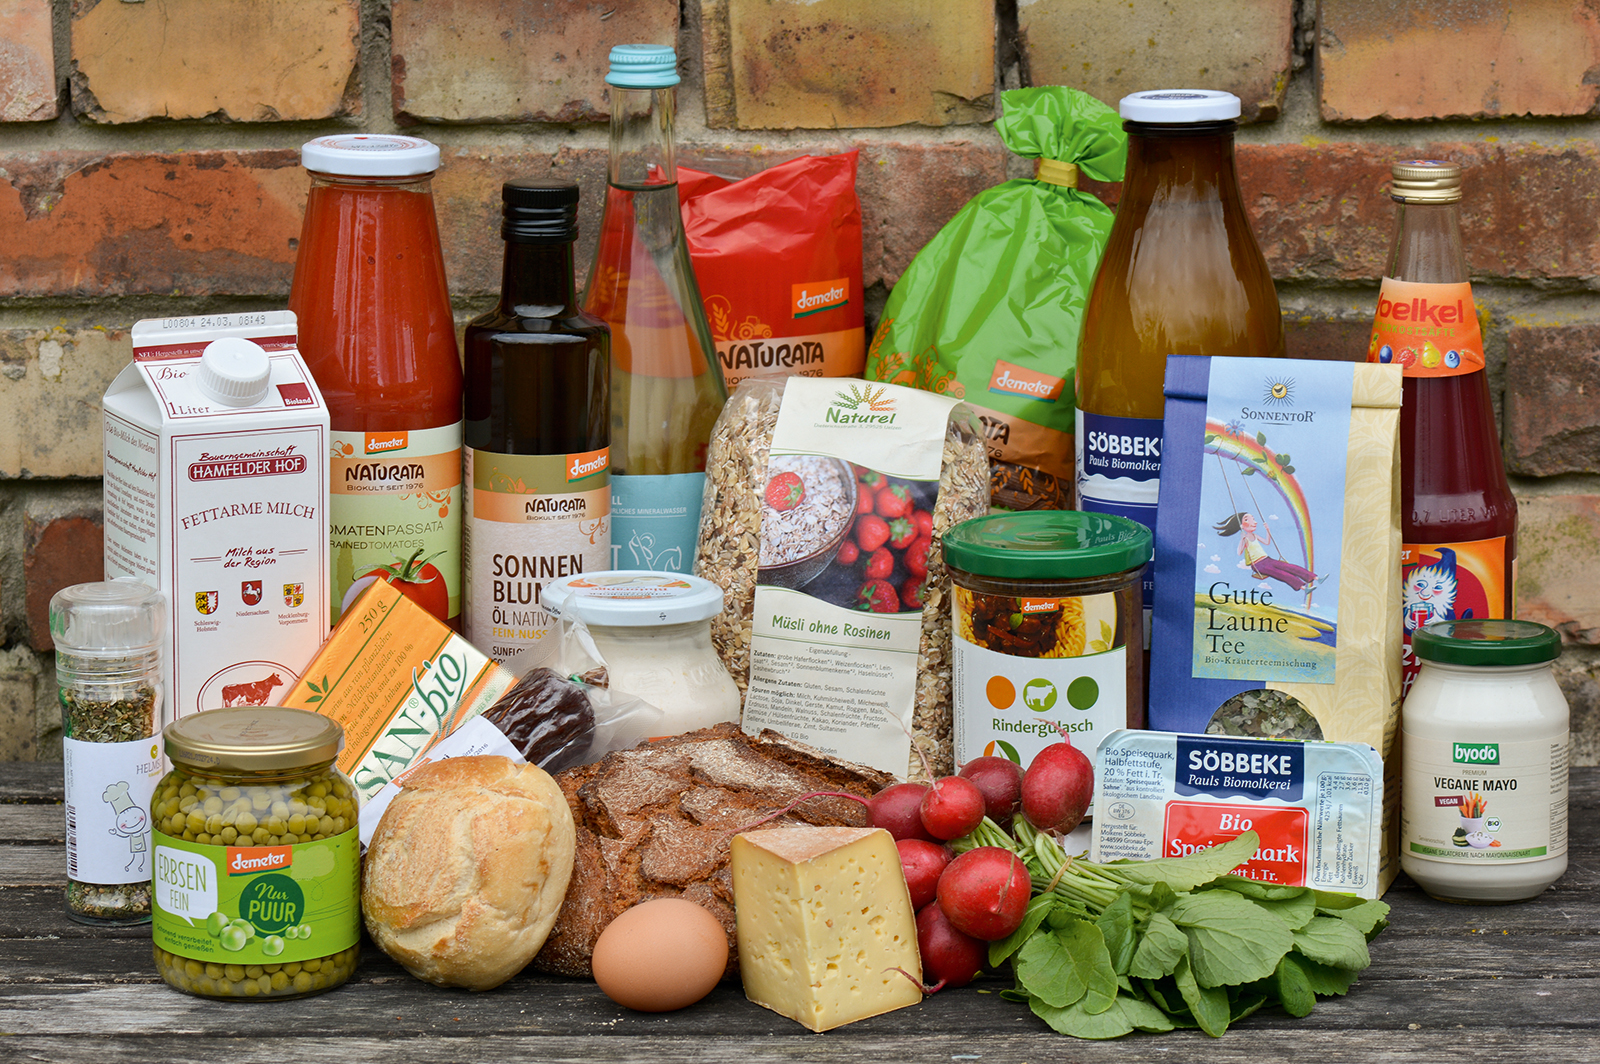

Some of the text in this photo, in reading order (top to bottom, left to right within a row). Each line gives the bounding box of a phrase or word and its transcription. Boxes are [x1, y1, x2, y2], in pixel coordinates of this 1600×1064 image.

[797, 287, 844, 309] demeter
[163, 318, 195, 329] L00804
[239, 315, 265, 324] 08:49
[1374, 321, 1455, 336] ATURKOSTSÄFTE
[718, 342, 824, 369] NATURATA
[156, 367, 189, 380] Bio
[996, 370, 1054, 394] demeter
[179, 405, 209, 414] Liter
[285, 397, 311, 405] Bioland
[826, 407, 896, 424] Naturel
[368, 438, 403, 450] demeter
[988, 446, 1002, 458] 76
[1089, 431, 1162, 457] SÖBBEK
[199, 445, 297, 462] Bauerngemeinschaft
[193, 459, 301, 479] HAMFELDER HOF
[570, 455, 607, 477] demeter
[1089, 455, 1161, 471] Pauls Biomolker
[346, 464, 424, 481] NATURATA
[525, 498, 586, 514] NATURATA
[612, 496, 622, 505] LL
[181, 502, 315, 530] FETTARME MILCH
[225, 547, 252, 557] Milch
[330, 541, 368, 549] RAINED
[224, 557, 276, 568] der Region
[493, 554, 583, 578] SONNEN
[494, 580, 541, 604] BLU
[1209, 582, 1273, 606] Gute
[1024, 601, 1055, 612] demeter
[358, 600, 388, 632] 250 g
[492, 606, 549, 626] ÖL NATIV
[1207, 608, 1288, 633] Laune
[493, 627, 548, 639] FEIN-NUSS
[772, 615, 891, 640] Müsli ohne Rosinen
[1206, 634, 1245, 654] Tee
[754, 650, 776, 658] Zutaten:
[343, 630, 394, 697] aus rein pflanzlichen
[1205, 656, 1317, 670] Bio-Kräuterteemischung
[357, 704, 369, 718] und
[366, 690, 378, 703] Öle
[376, 676, 390, 691] sind
[388, 667, 397, 677] zu
[395, 652, 407, 665] 100
[752, 686, 770, 694] Spuren
[753, 675, 777, 684] Allergene
[778, 680, 802, 688] Zutaten:
[846, 687, 886, 696] Schalenfrüchte
[350, 706, 384, 749] biologischem
[992, 718, 1093, 737] Rindergulasch
[1121, 749, 1174, 760] Speisequark,
[1455, 745, 1496, 762] byodo
[1105, 758, 1162, 769] Halbfettstufe,
[1188, 750, 1291, 775] SÖBBEKE
[1188, 774, 1291, 790] Pauls Biomolkerei
[1434, 777, 1517, 791] VEGANE MAYO
[1101, 823, 1128, 831] Hergestellt
[1219, 814, 1252, 831] Bio
[232, 853, 285, 870] demeter
[158, 854, 206, 892] ERBSEN
[1261, 869, 1278, 880] Tr.
[170, 889, 189, 912] FEIN
[254, 883, 289, 901] Nur
[249, 900, 296, 923] PUUR
[164, 936, 214, 953] einfach genießen
